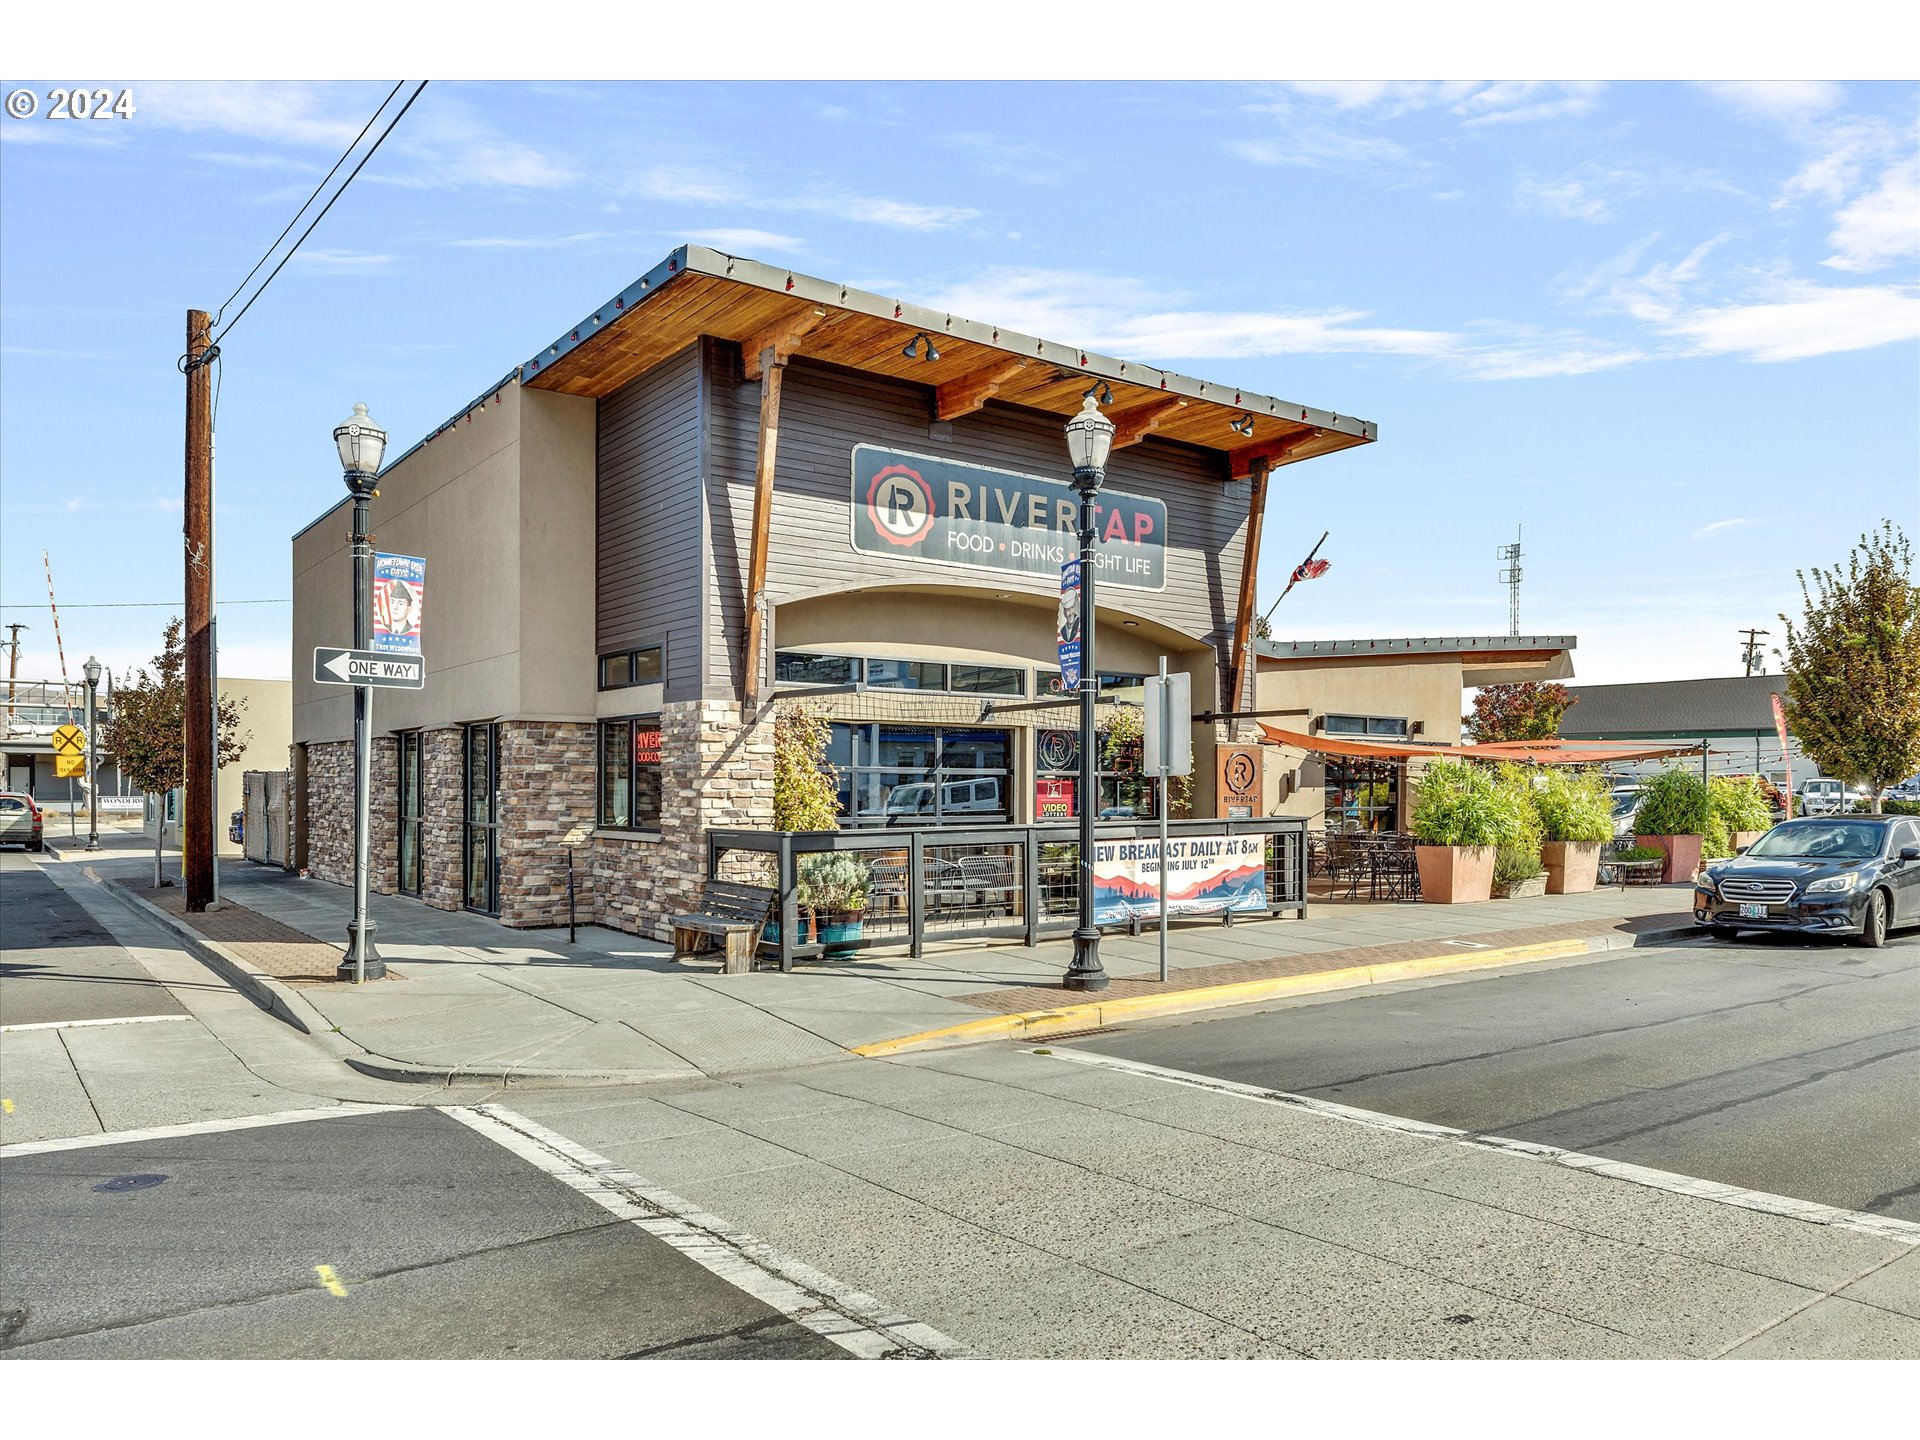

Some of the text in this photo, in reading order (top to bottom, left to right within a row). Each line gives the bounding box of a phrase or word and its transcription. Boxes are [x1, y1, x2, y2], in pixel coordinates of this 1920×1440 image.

[947, 480, 1154, 547] RIVERAP
[947, 530, 994, 553] FOOD
[1011, 540, 1064, 564] DRINKS
[1094, 552, 1122, 571] GHT
[1125, 557, 1150, 575] LIFE
[349, 661, 412, 677] ONE WAY
[55, 736, 83, 744] R R
[1042, 803, 1068, 812] VIDEO
[1119, 842, 1187, 861] BREAKAST
[1190, 841, 1222, 857] DAILY
[1225, 840, 1239, 855] AT
[1141, 860, 1180, 872] BEGINING
[1181, 859, 1198, 870] JULY
